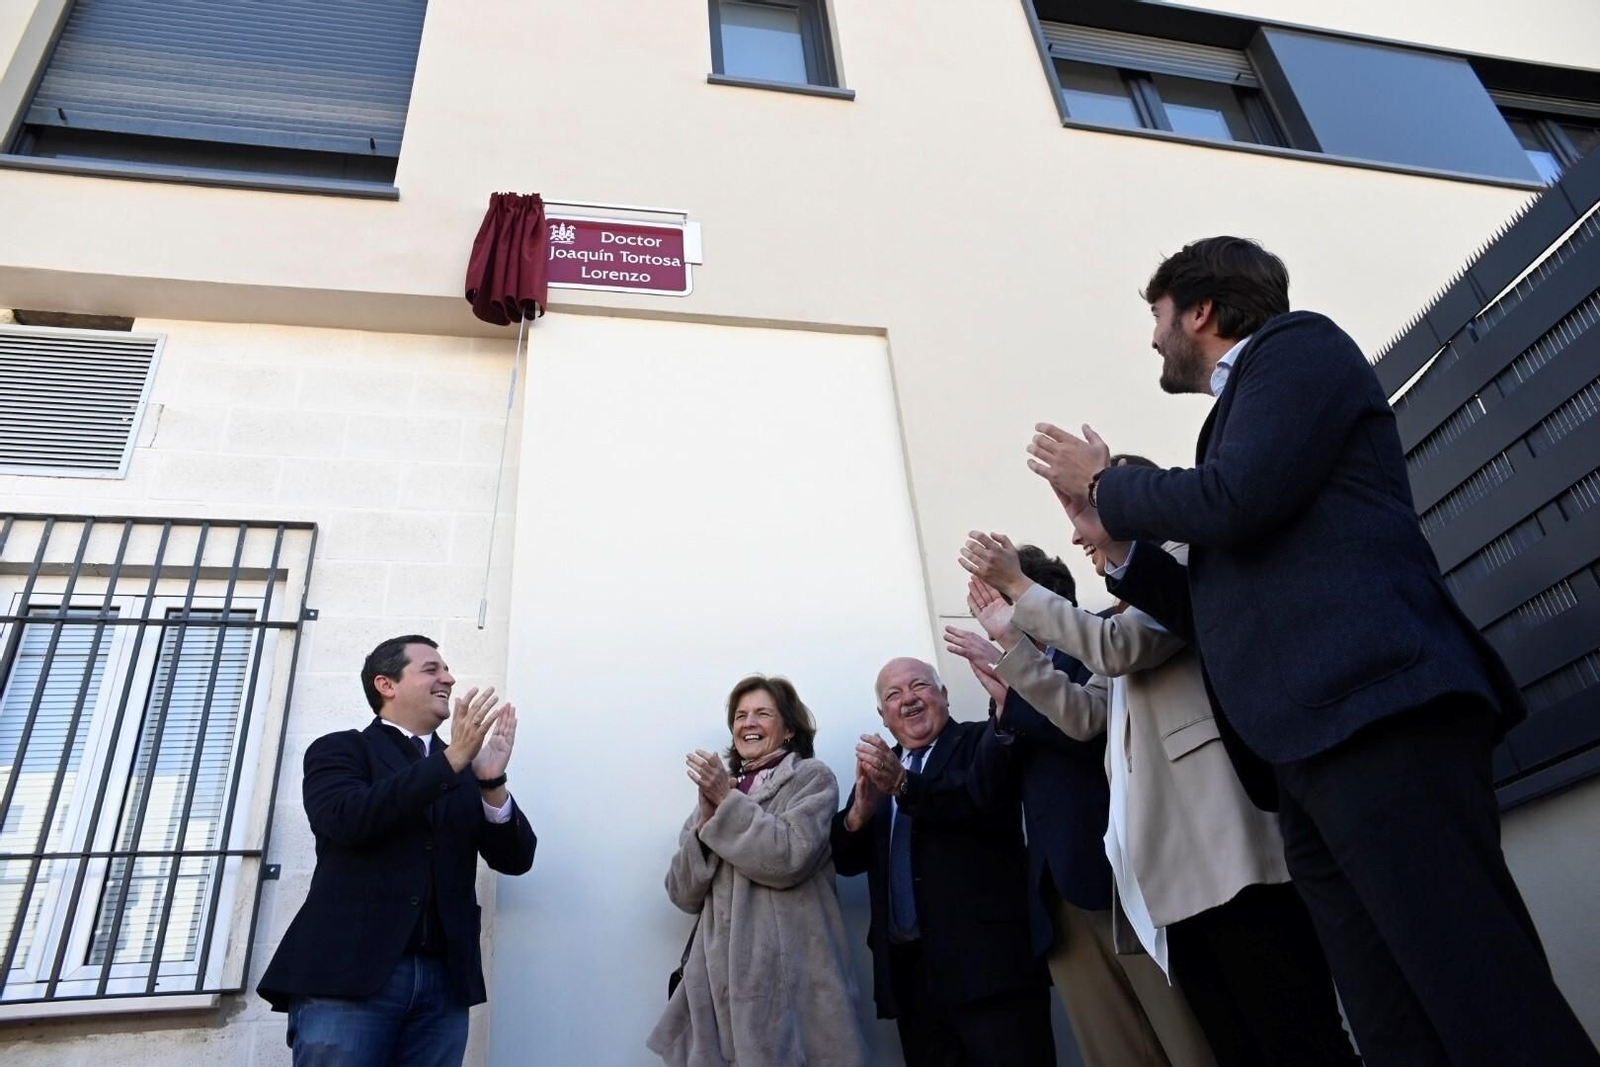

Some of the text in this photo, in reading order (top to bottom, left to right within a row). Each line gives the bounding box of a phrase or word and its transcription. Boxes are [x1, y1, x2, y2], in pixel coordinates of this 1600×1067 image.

[601, 231, 662, 247] Doctor
[549, 246, 681, 267] Joaquín Tortosa
[581, 266, 651, 283] Lorenzo
